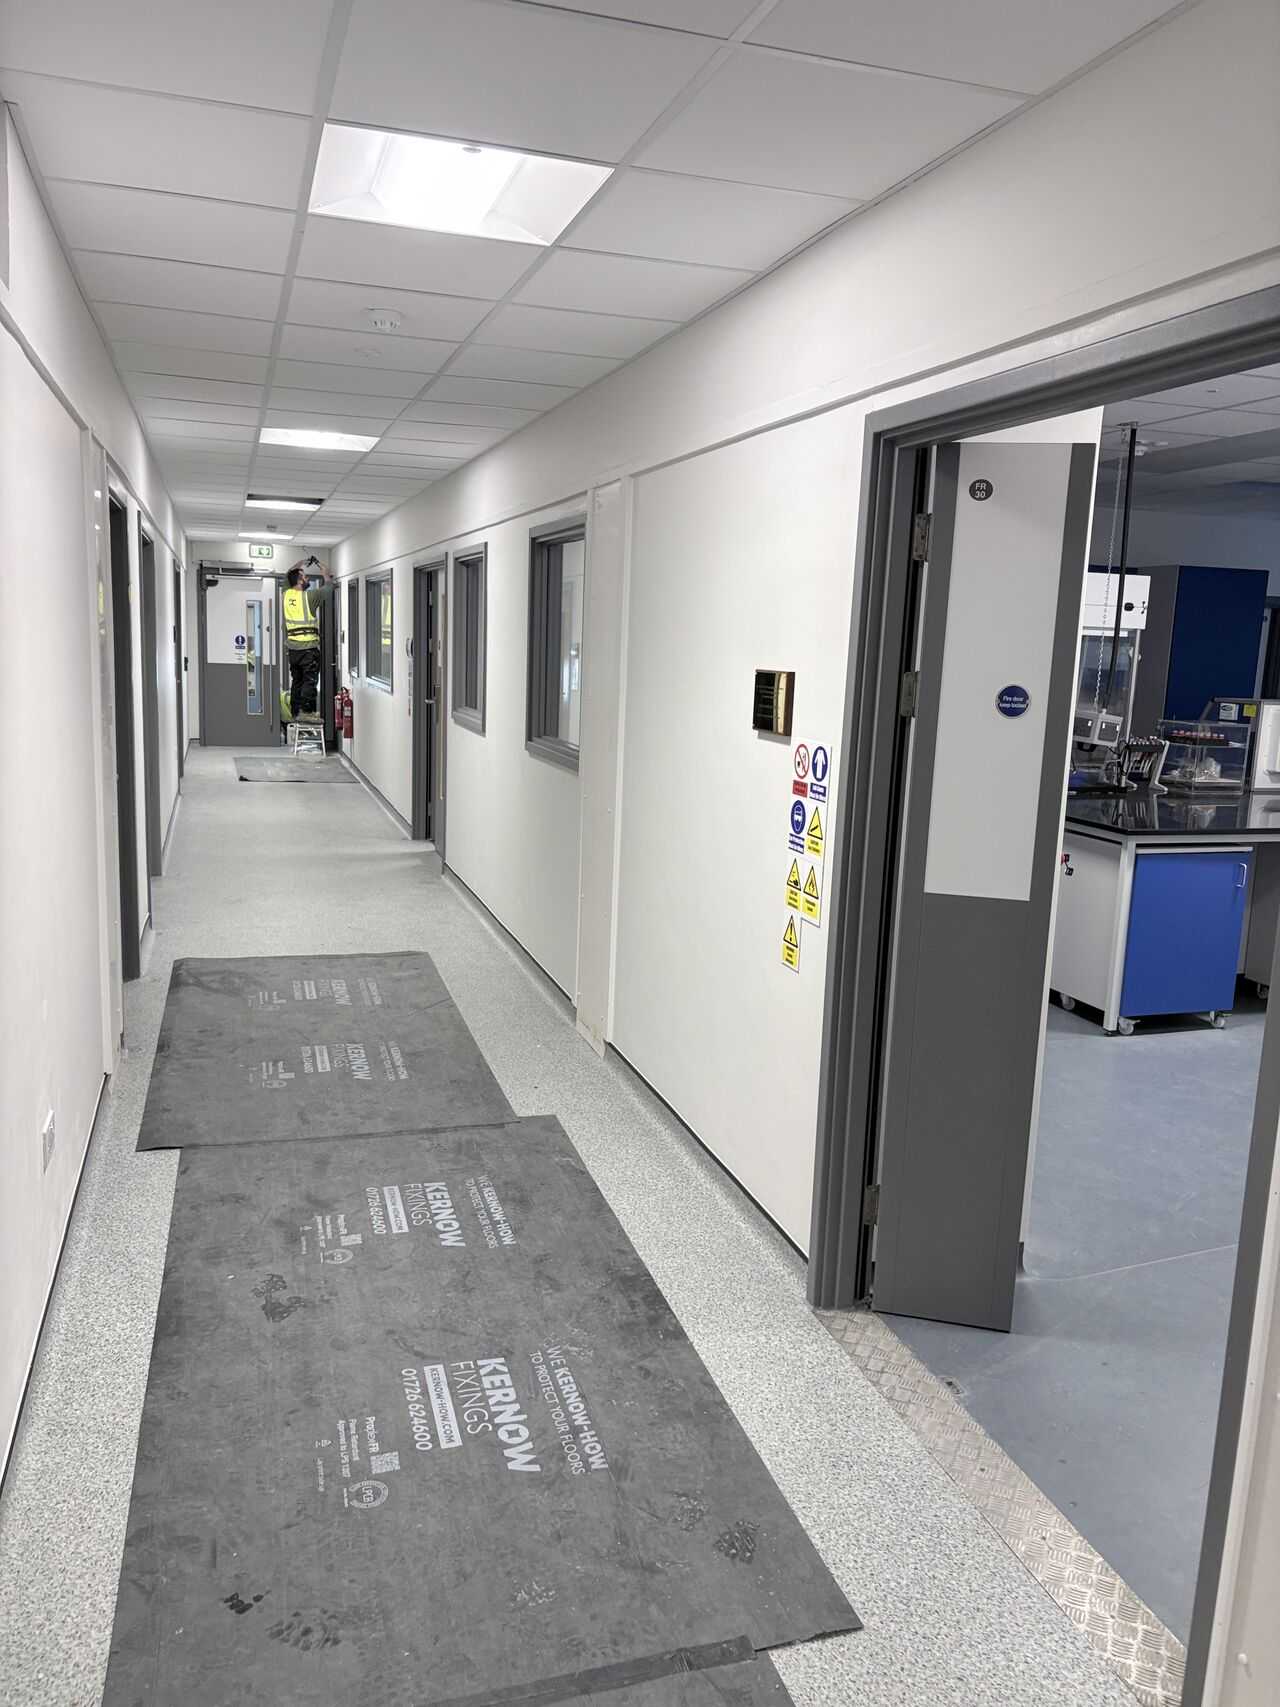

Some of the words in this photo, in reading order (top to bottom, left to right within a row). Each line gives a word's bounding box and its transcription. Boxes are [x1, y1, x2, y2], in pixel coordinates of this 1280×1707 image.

[975, 482, 986, 490] FR
[403, 1183, 432, 1226] FIXINGS
[423, 1181, 466, 1247] KERNOW
[529, 1349, 543, 1364] TO
[545, 1344, 566, 1369] WE
[401, 1368, 423, 1402] 01726
[429, 1366, 457, 1445] KERNOW-HOW.COM
[450, 1360, 492, 1435] FIXINGS
[534, 1363, 560, 1406] PROTECT
[408, 1402, 433, 1450] 624600
[477, 1357, 541, 1472] KERNOW
[550, 1403, 570, 1435] YOUR
[554, 1366, 609, 1471] KERNOW-HOW
[560, 1434, 586, 1476] FLOORS
